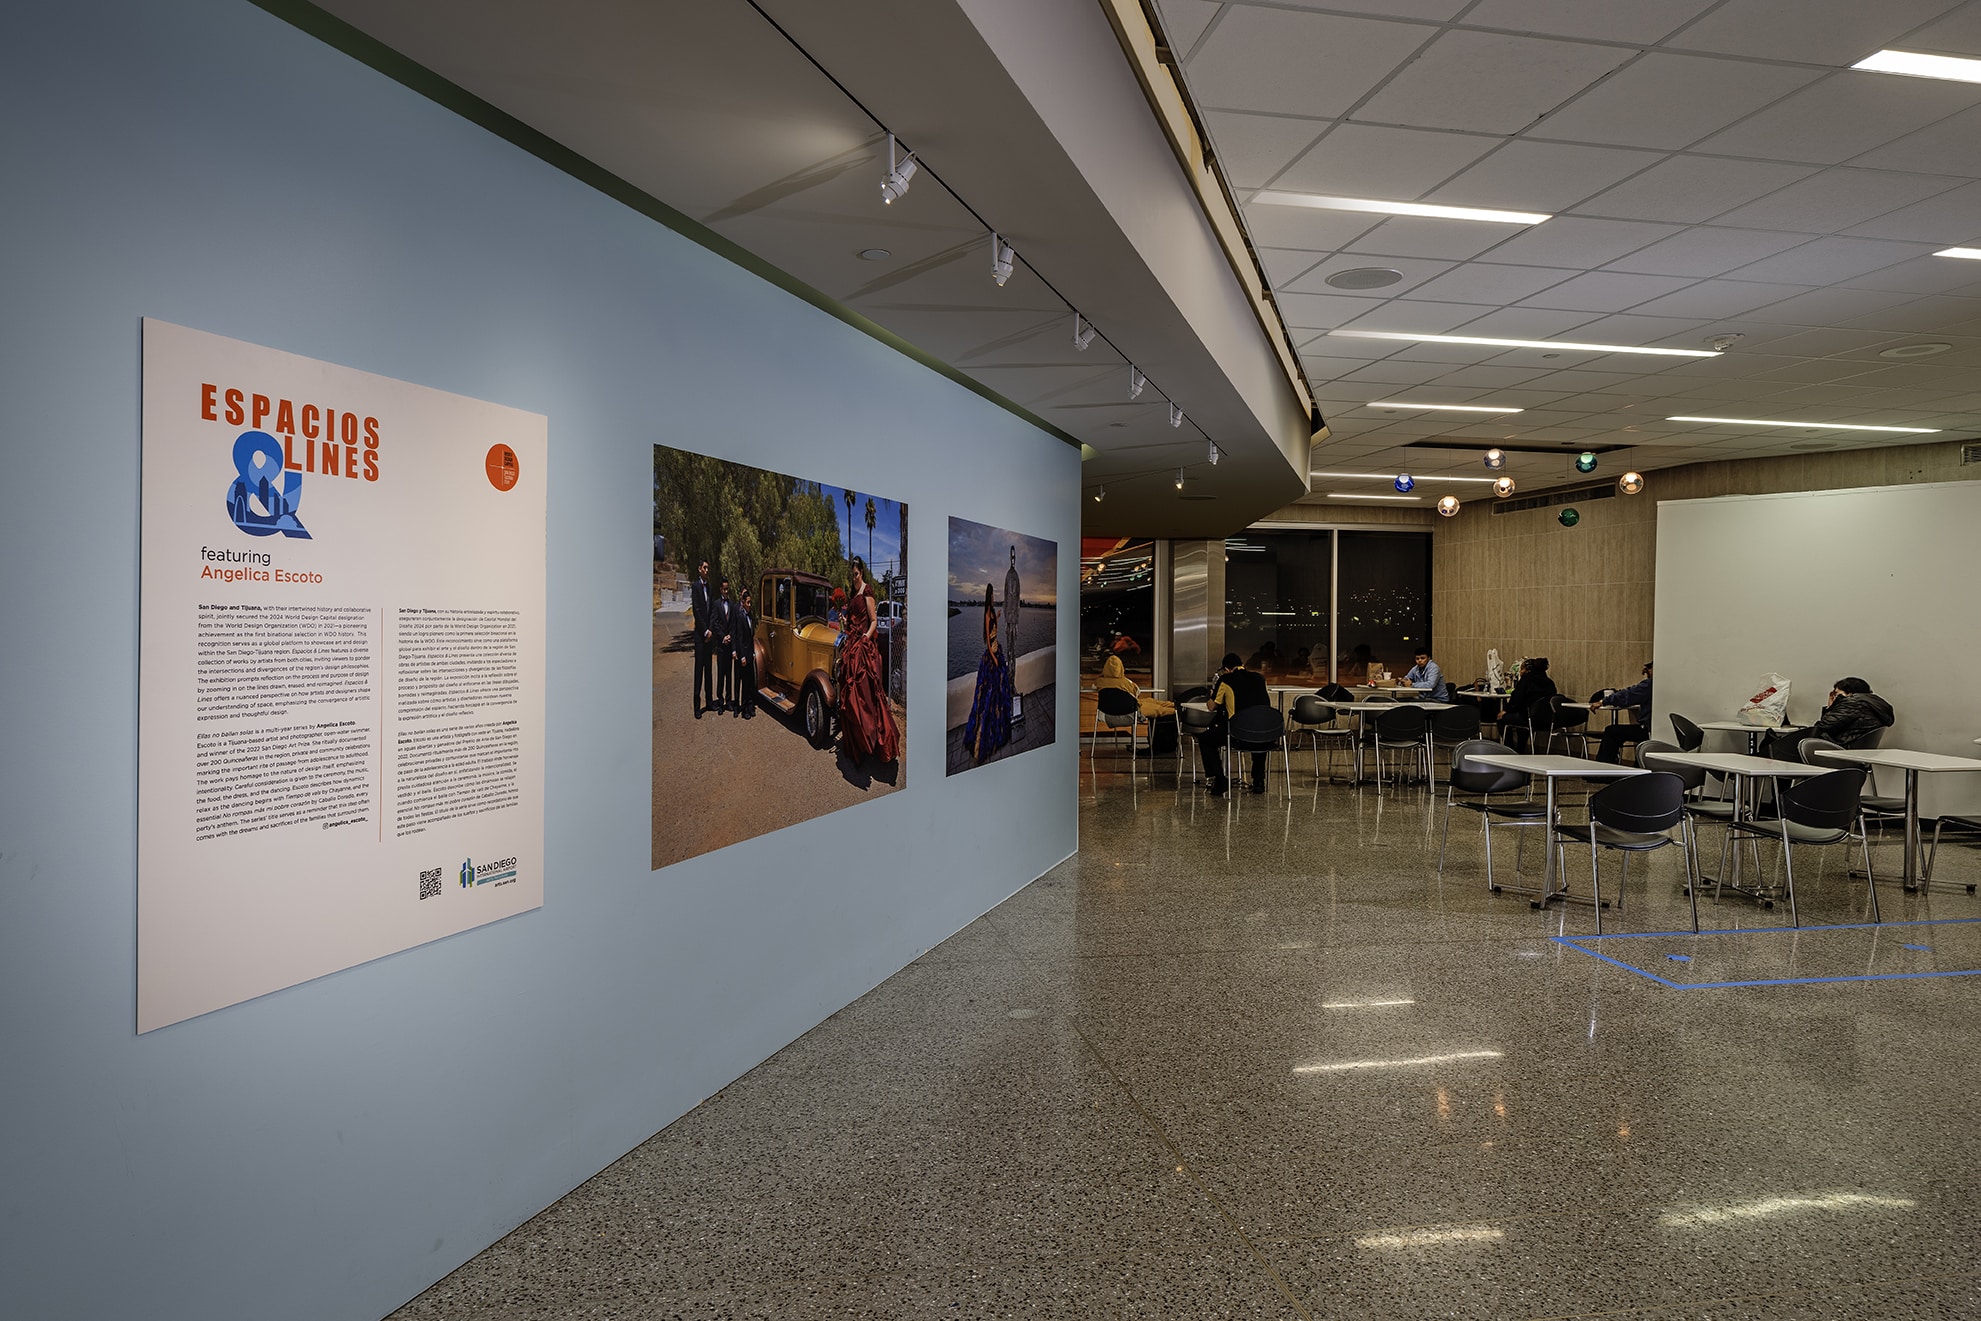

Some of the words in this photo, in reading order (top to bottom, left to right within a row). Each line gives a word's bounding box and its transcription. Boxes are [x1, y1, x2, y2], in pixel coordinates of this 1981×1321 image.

[201, 383, 380, 449] ESPACIOS
[226, 430, 313, 540] &
[284, 434, 380, 482] LINES
[201, 546, 271, 566] featuring
[201, 566, 269, 583] Angelica
[275, 568, 323, 584] Escoto
[197, 713, 228, 722] expression
[242, 710, 269, 718] thoughtful
[266, 726, 292, 734] multi-year
[223, 755, 258, 764] Quinceañeras
[240, 772, 262, 781] homage
[477, 863, 493, 874] SAN
[494, 857, 517, 870] DIEGO
